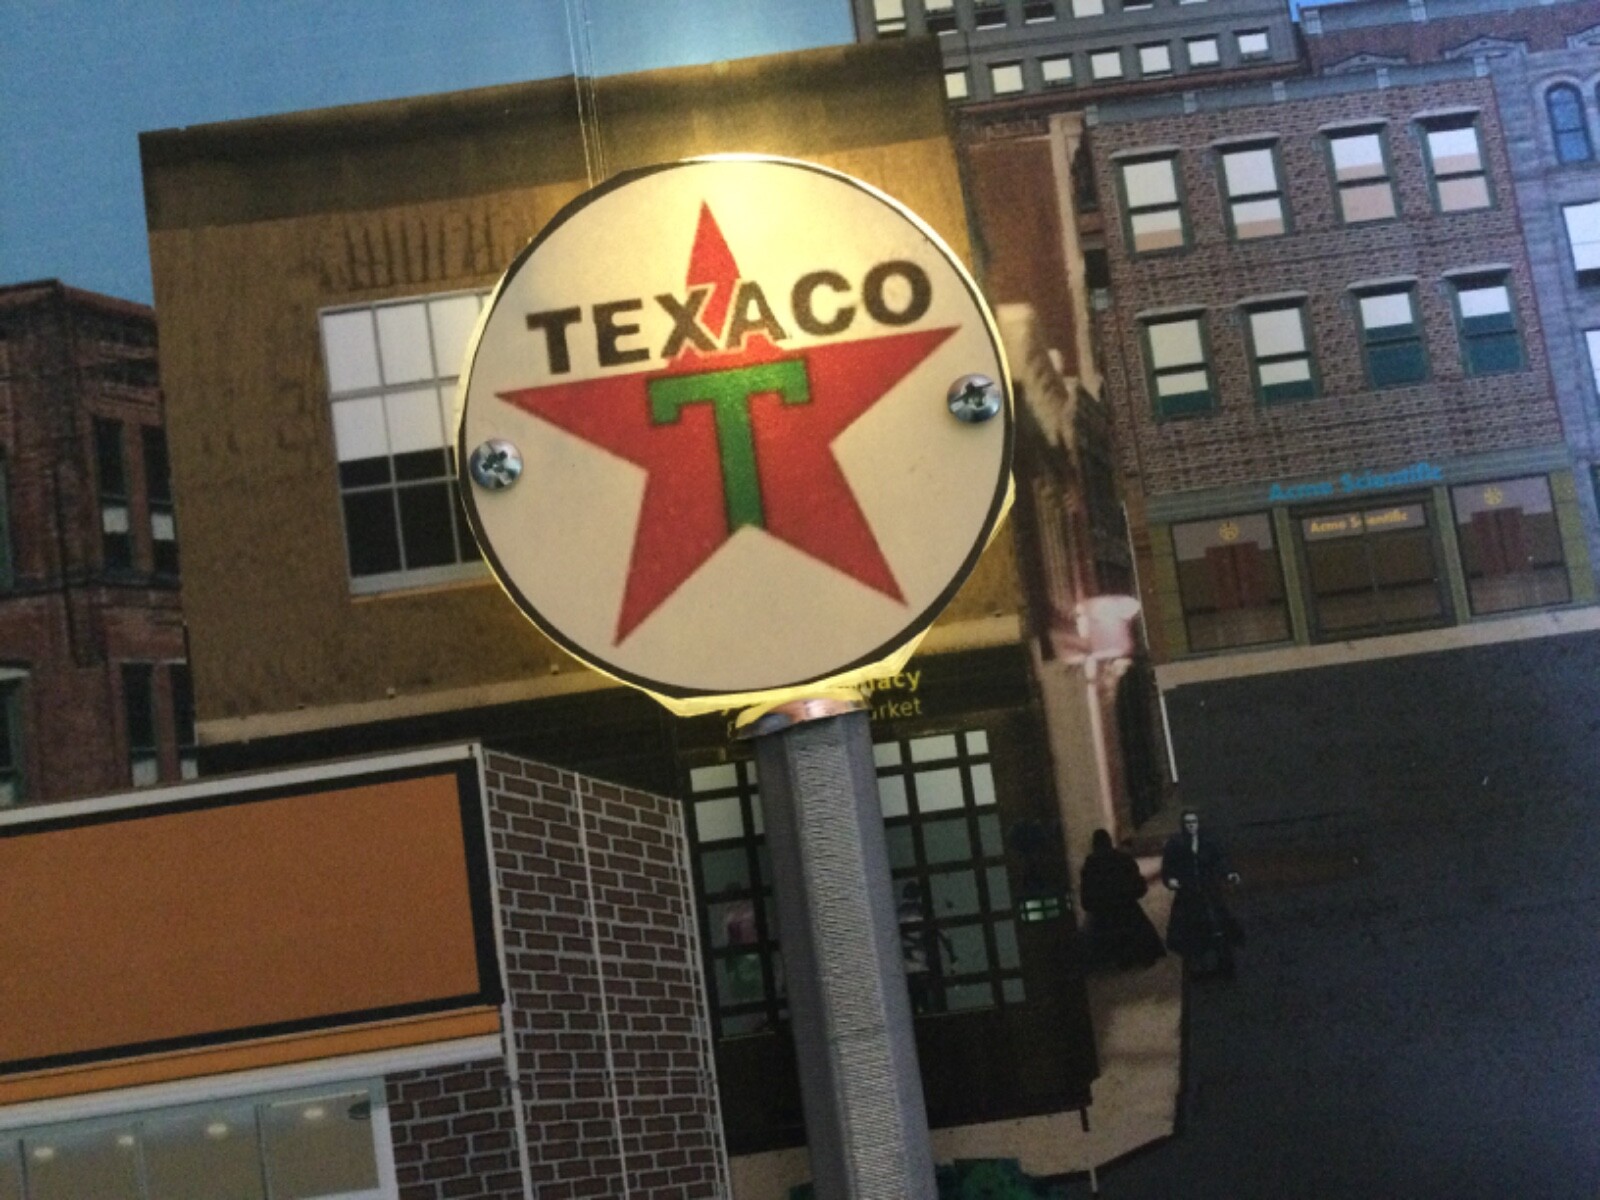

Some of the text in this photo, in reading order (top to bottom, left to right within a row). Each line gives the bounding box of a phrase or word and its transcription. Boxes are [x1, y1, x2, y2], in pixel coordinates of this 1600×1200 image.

[525, 259, 933, 375] TEXACO
[645, 356, 813, 534] T
[1268, 461, 1442, 501] Acme Scientific
[1310, 508, 1408, 533] Acme Scentific
